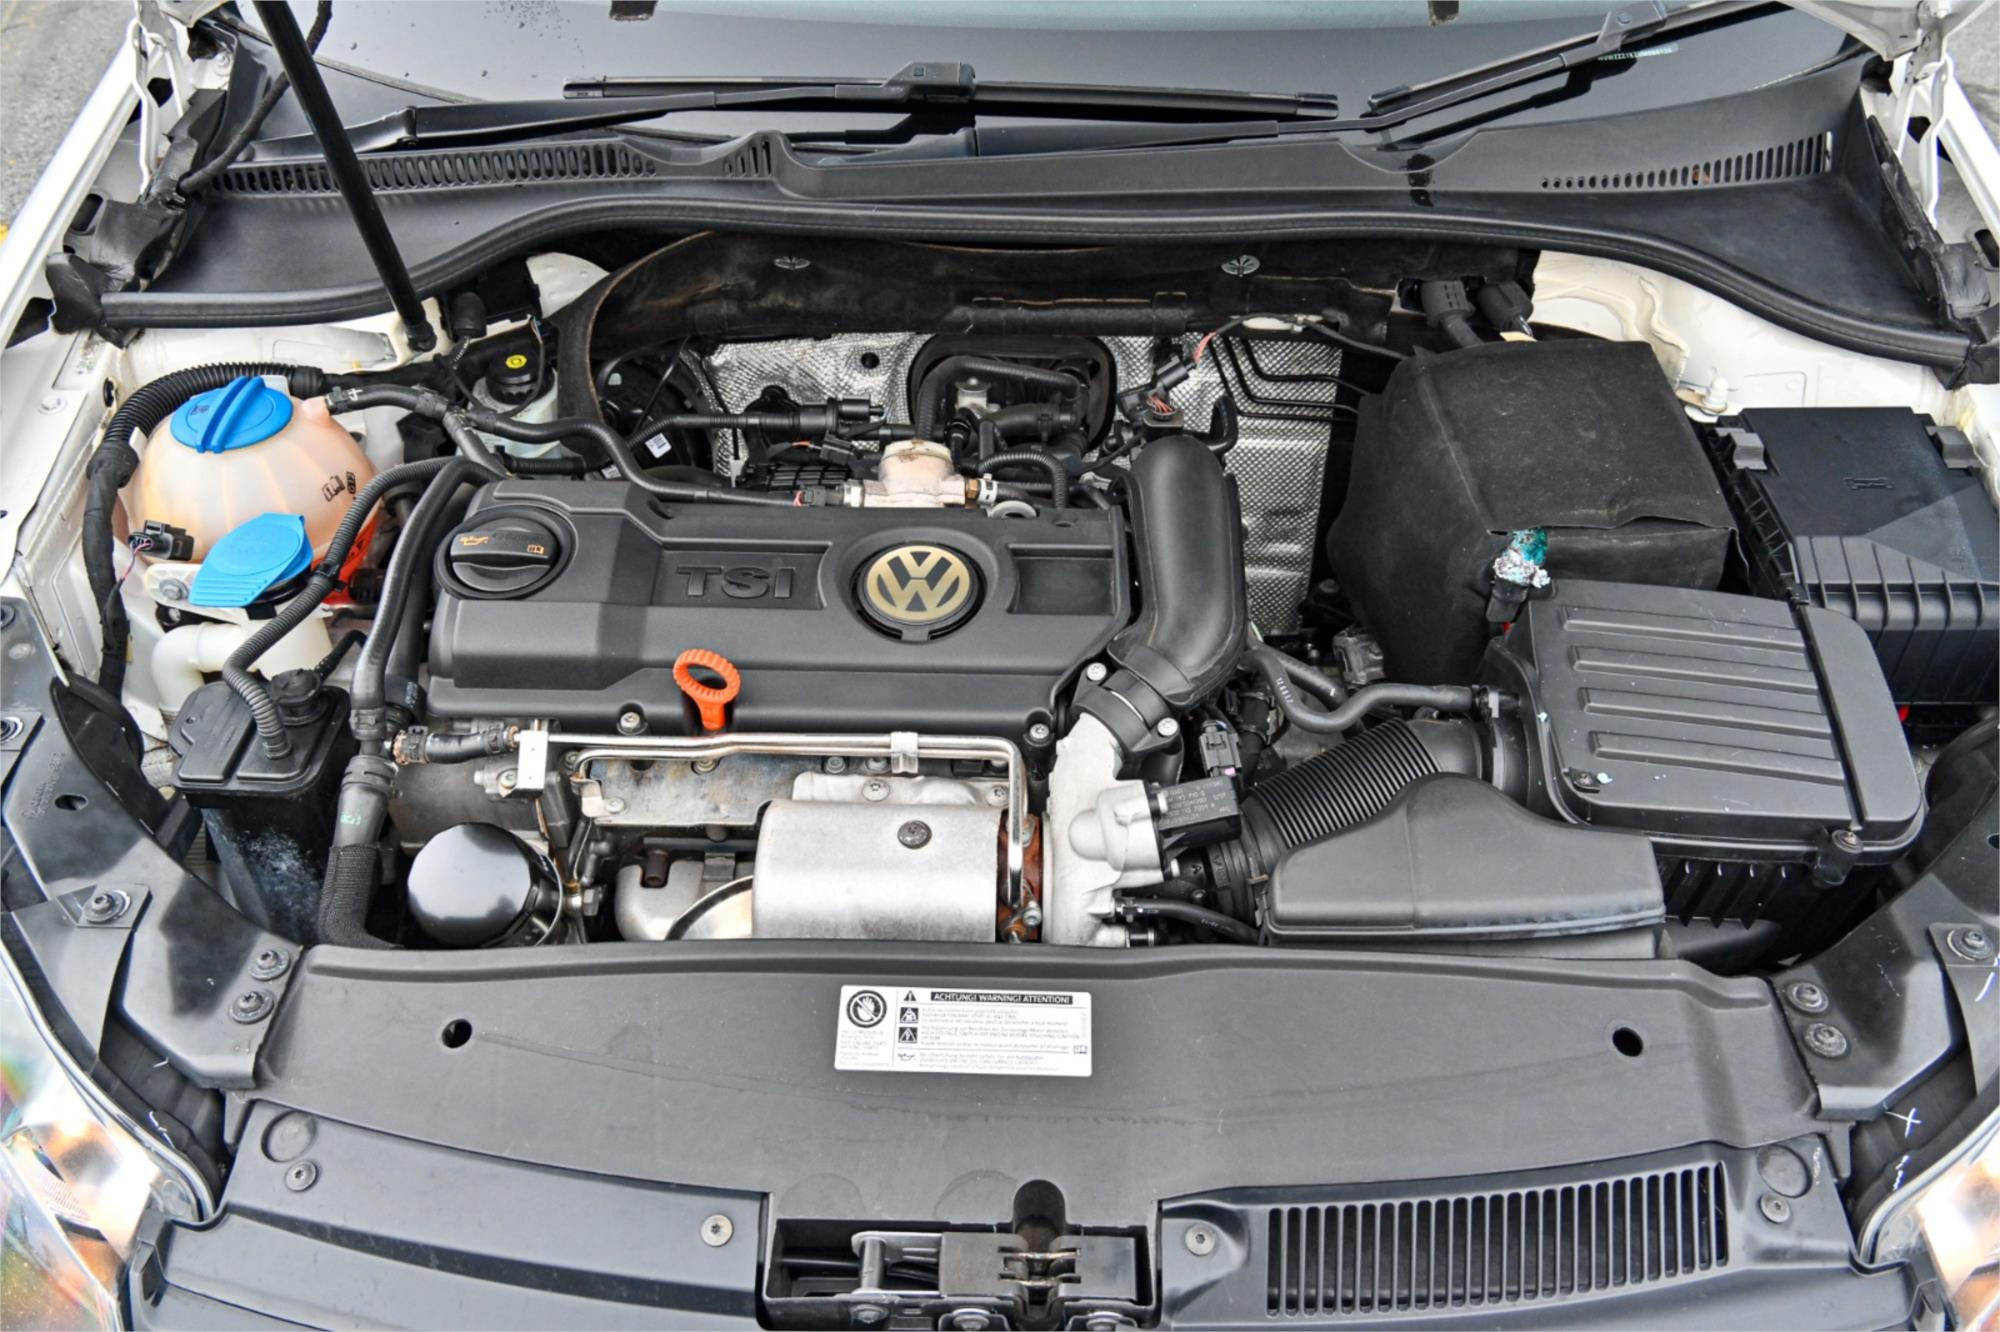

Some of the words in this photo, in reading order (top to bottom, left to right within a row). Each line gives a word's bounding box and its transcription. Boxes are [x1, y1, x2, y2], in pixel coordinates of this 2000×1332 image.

[677, 565, 798, 599] TSI
[867, 545, 970, 622] VW
[933, 992, 977, 1002] ACHTUNG!
[979, 993, 1021, 1003] WARNING!
[1022, 995, 1071, 1005] ATTENTION!
